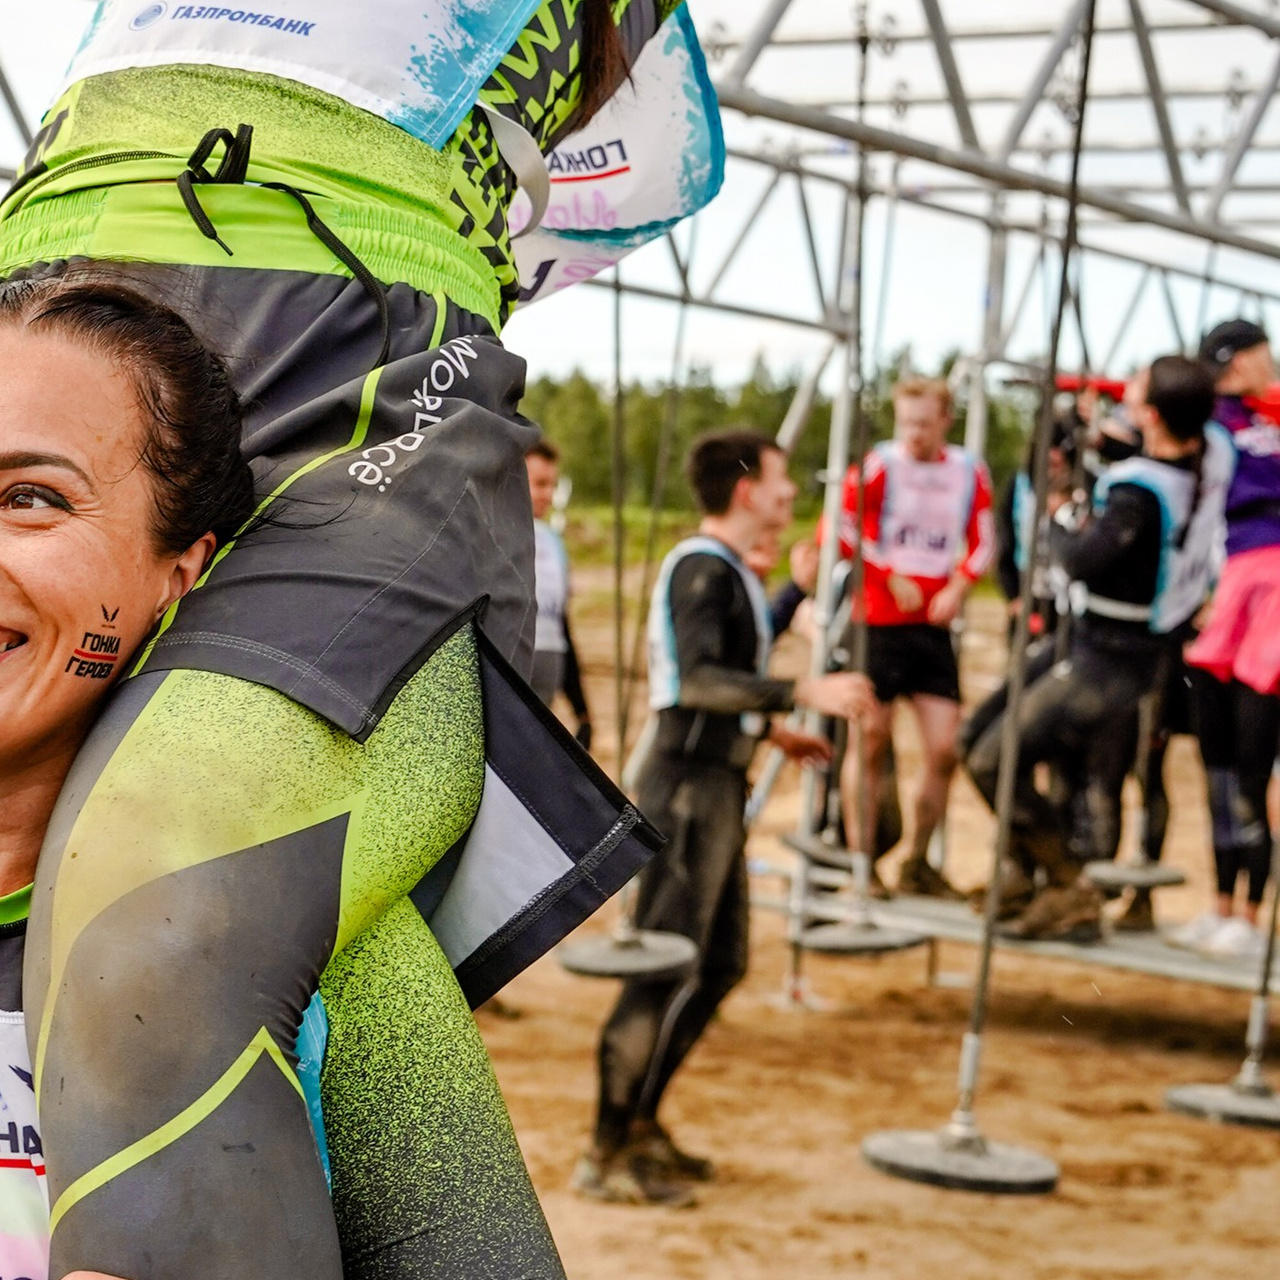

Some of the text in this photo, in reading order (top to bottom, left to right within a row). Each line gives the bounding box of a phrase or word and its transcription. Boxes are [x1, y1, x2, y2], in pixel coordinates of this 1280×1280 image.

[171, 6, 318, 36] ГАЗПРОМБАНК
[81, 632, 121, 654] ГОНКА
[65, 656, 114, 679] ГЕРОЕВ
